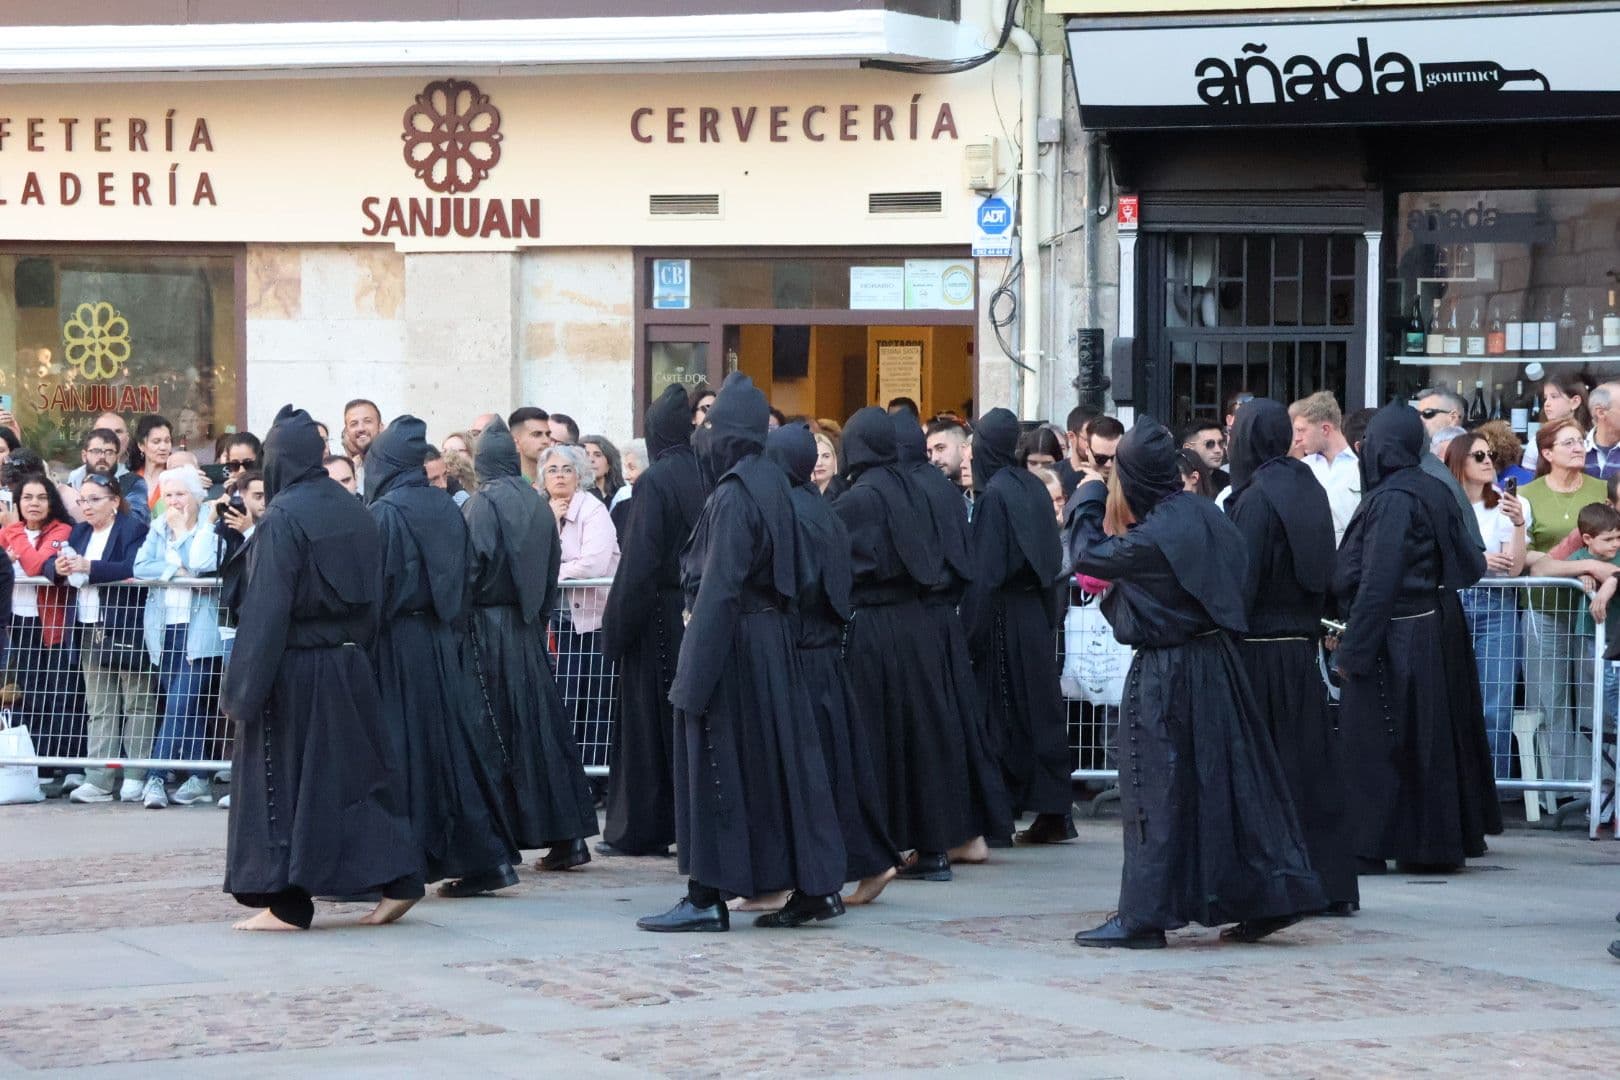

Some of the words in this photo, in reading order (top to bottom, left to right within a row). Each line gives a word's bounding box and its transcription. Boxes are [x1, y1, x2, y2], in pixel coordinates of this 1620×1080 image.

[1194, 37, 1417, 105] añada
[1425, 69, 1499, 87] gourmet
[630, 94, 959, 143] CERVECERÍA
[362, 196, 541, 238] SANJUAN
[983, 209, 1006, 224] ADT
[661, 266, 684, 285] CB
[36, 384, 160, 413] SANJUAN
